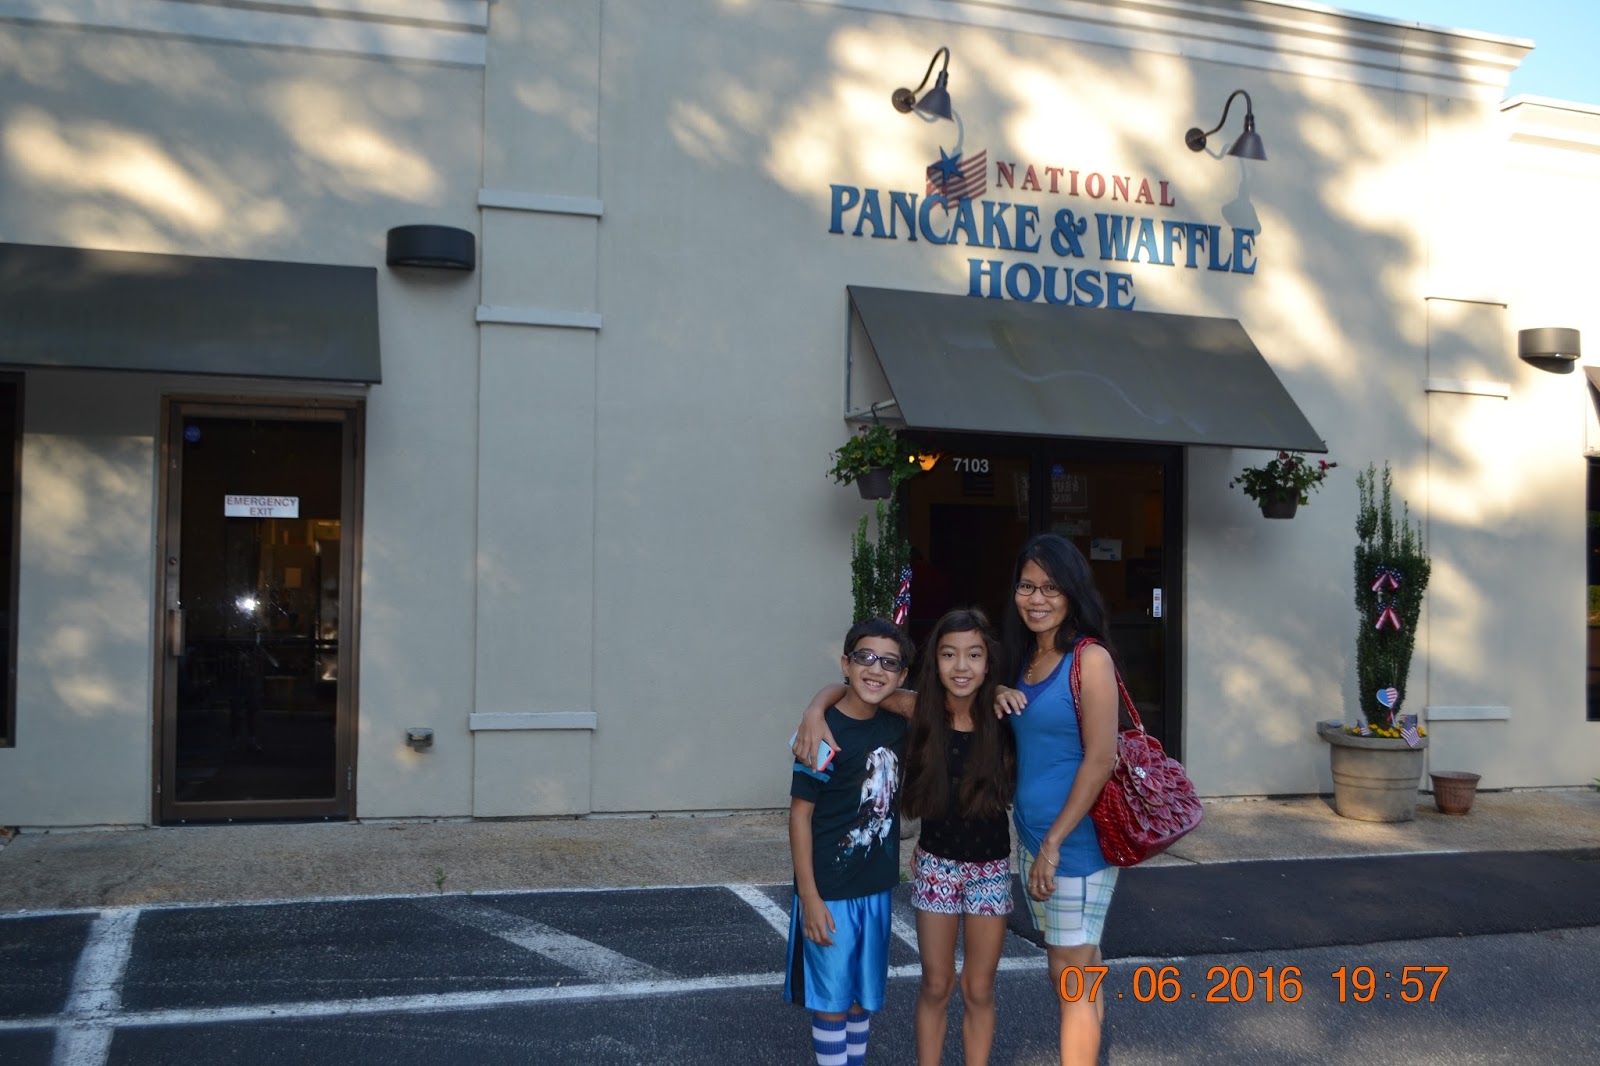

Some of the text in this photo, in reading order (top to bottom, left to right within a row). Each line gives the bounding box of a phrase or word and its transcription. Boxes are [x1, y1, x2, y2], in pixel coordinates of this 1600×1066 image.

[996, 161, 1176, 207] NATIONAL
[828, 184, 1258, 274] PANCAKE & WAFFLE
[967, 258, 1136, 311] HOUSE
[953, 457, 989, 473] 7103
[226, 496, 297, 507] EMERGENCY
[249, 507, 274, 516] EXIT
